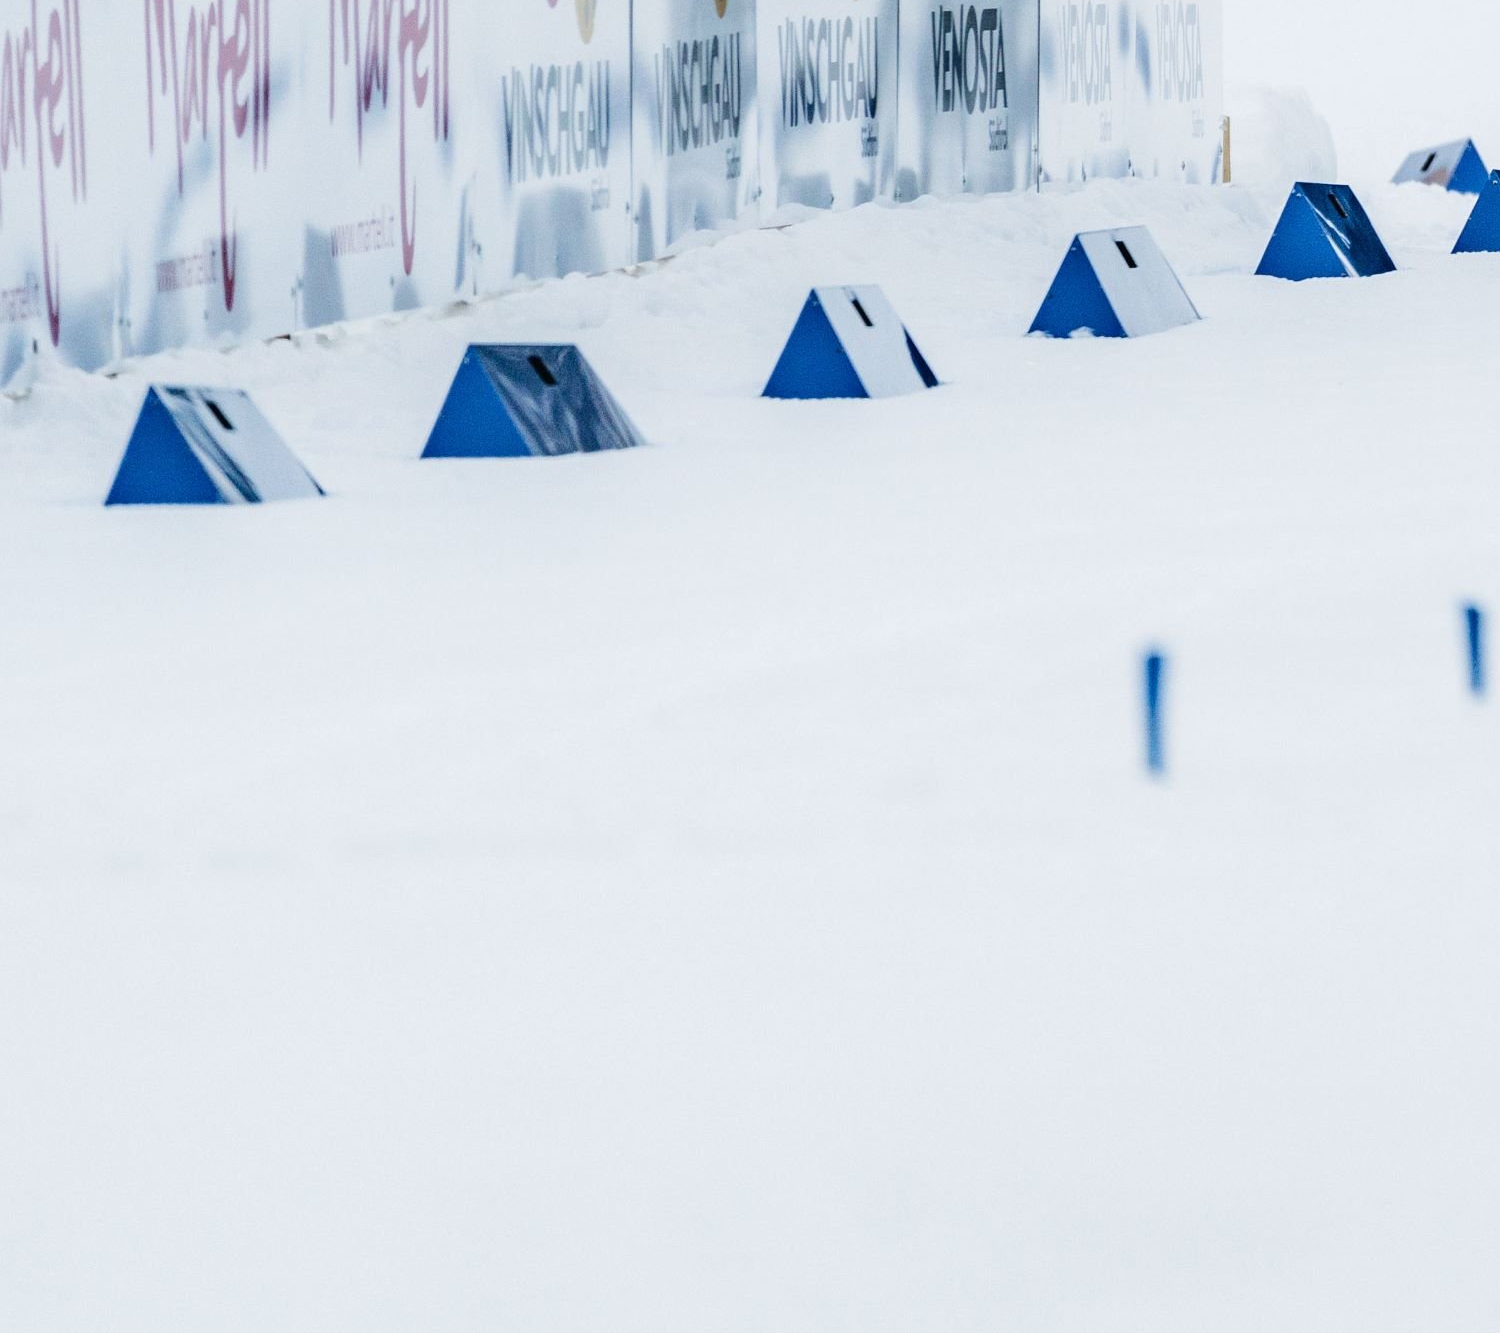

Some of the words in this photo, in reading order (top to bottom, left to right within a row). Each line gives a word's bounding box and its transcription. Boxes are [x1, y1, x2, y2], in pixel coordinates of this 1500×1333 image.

[655, 32, 741, 157] VINSCHGAU
[777, 15, 878, 131] VINSCHGAU
[931, 4, 1008, 115] VENOSTA
[502, 60, 610, 184] VINSCHGAU
